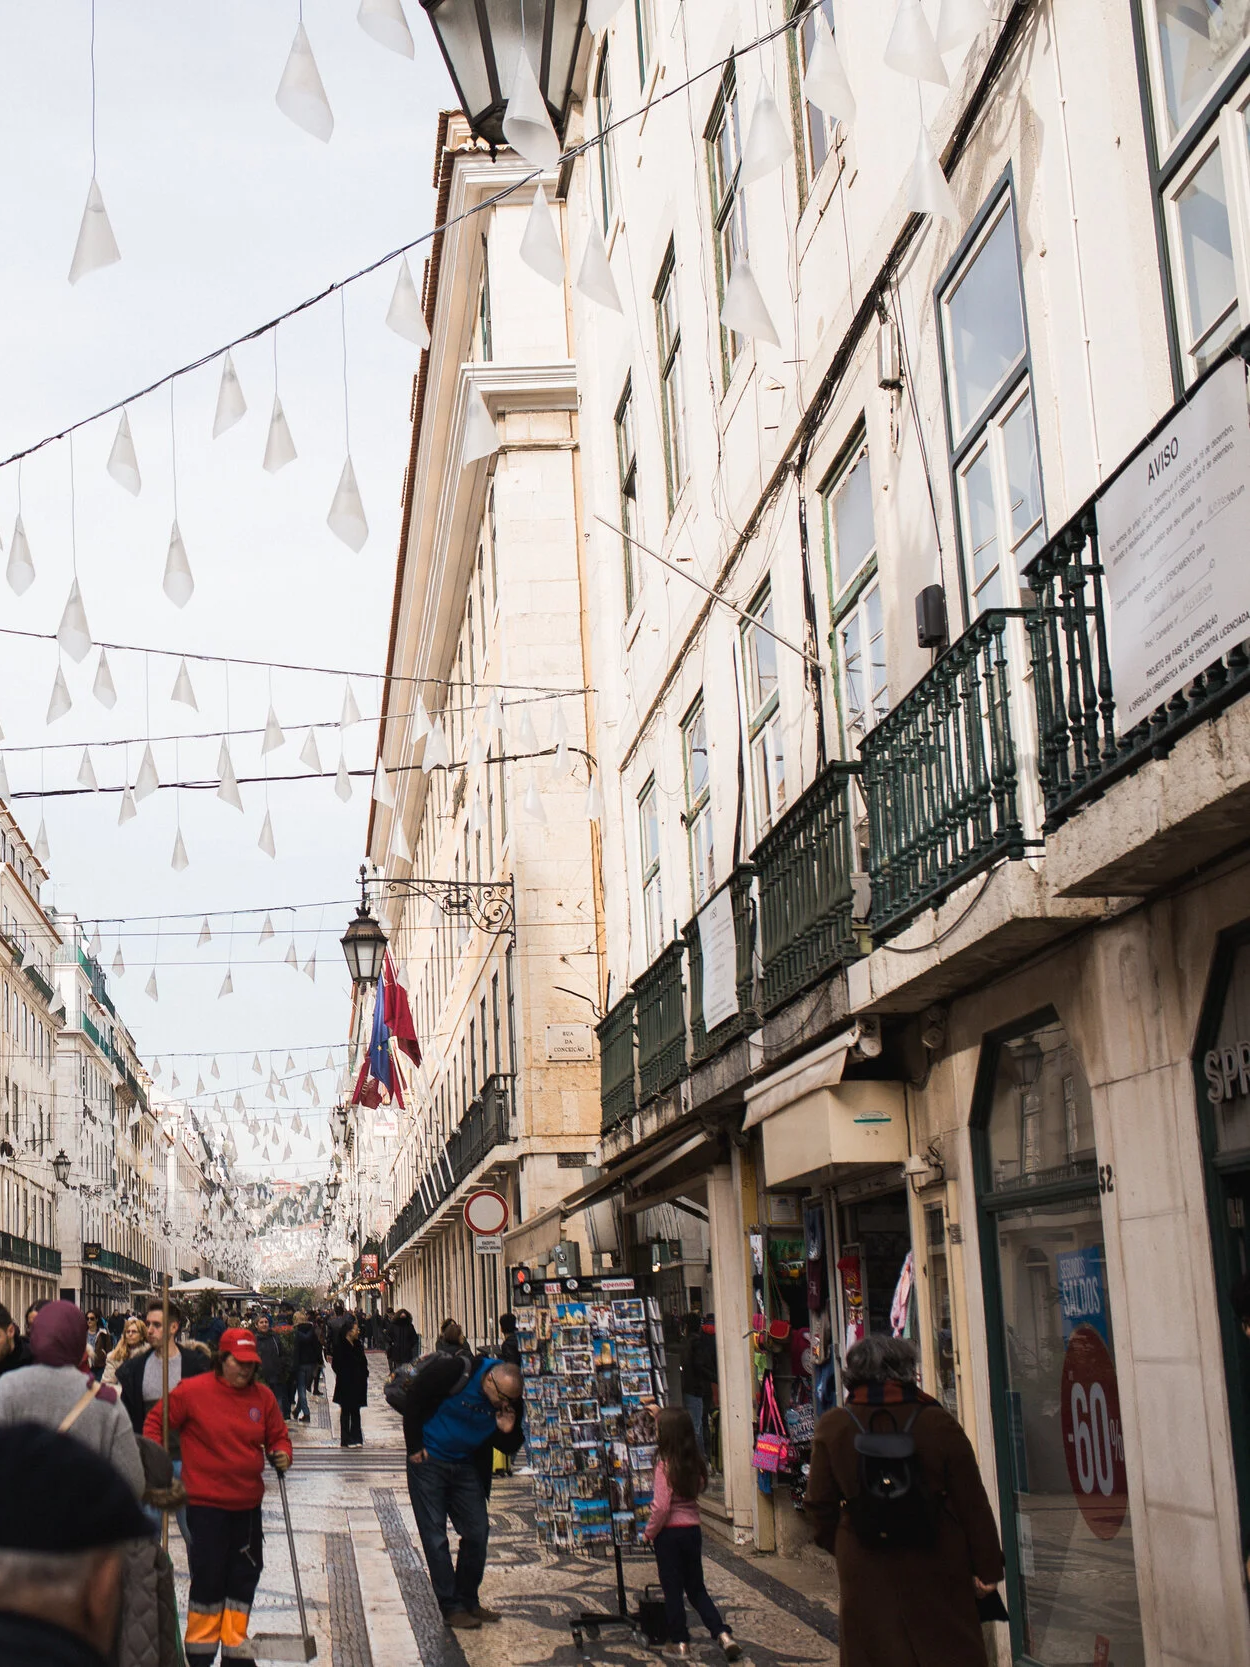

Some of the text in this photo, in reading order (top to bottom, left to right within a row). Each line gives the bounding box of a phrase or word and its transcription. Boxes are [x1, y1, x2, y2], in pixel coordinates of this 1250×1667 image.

[1148, 437, 1179, 486] AVISO
[1099, 1164, 1114, 1195] 52
[602, 1280, 635, 1290] openmail
[1062, 1276, 1101, 1317] SALDOS
